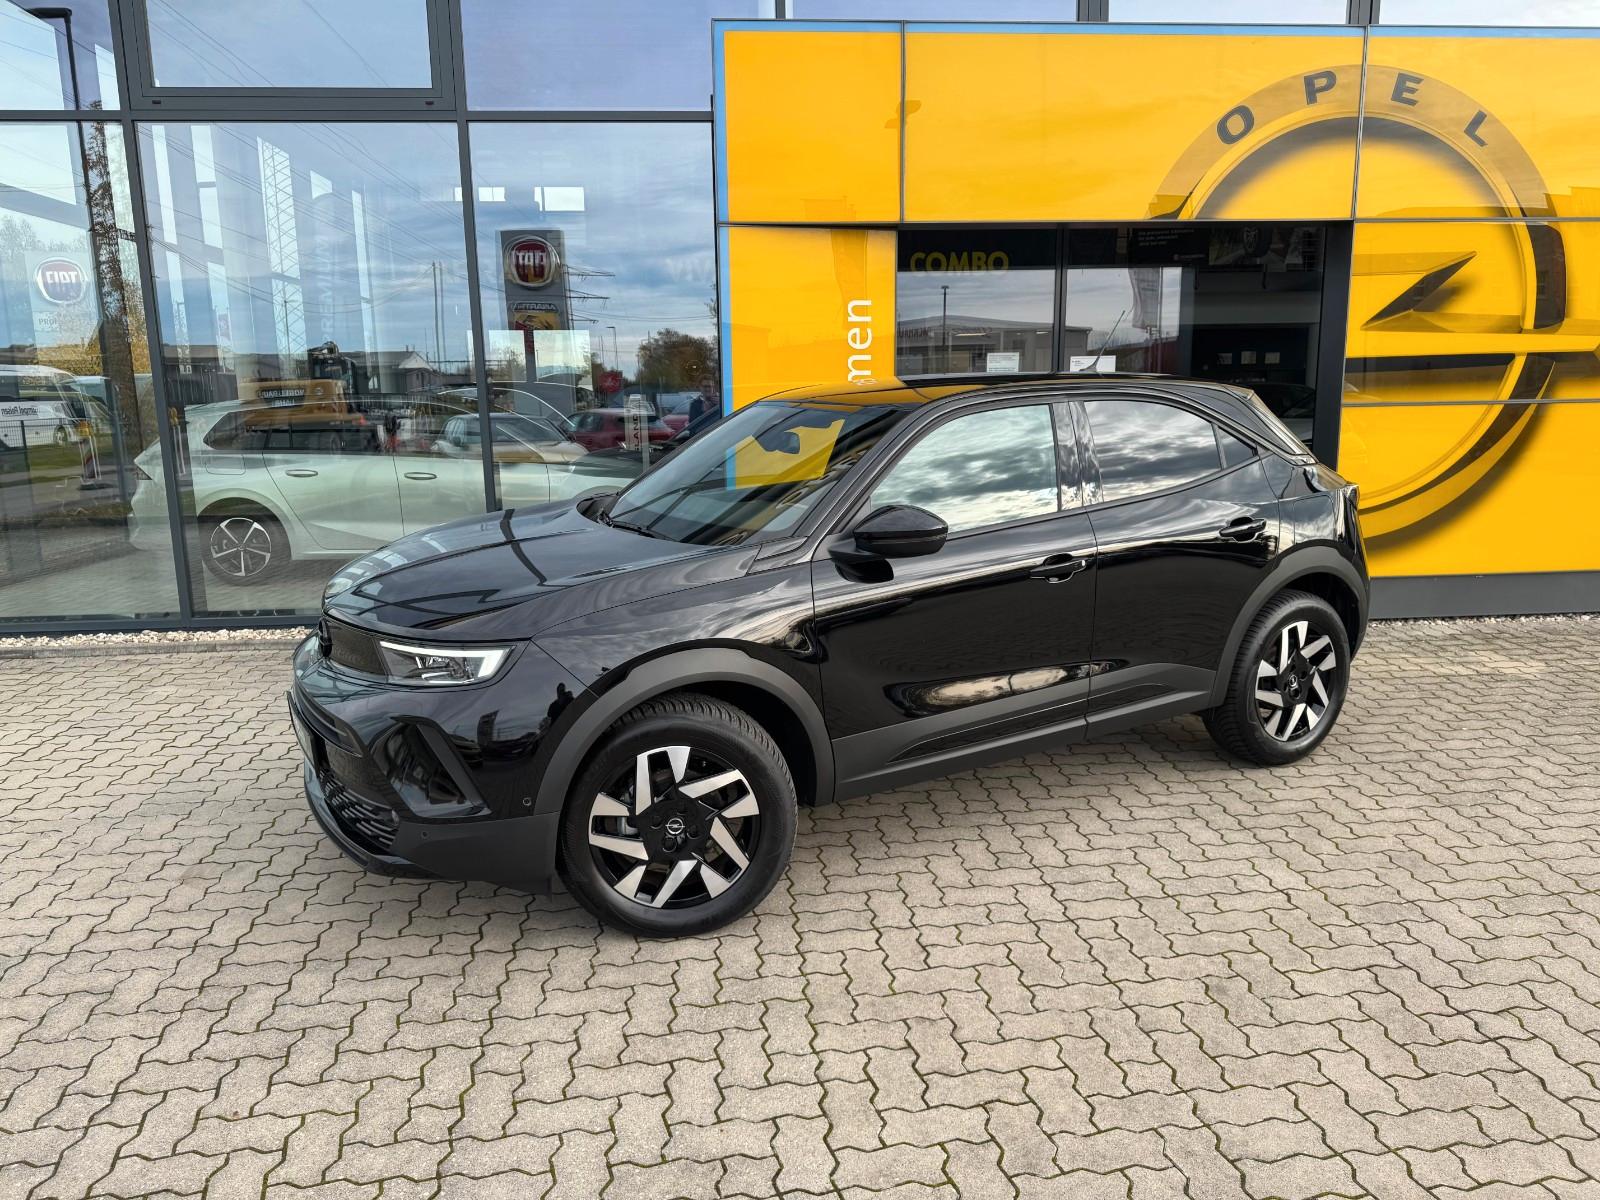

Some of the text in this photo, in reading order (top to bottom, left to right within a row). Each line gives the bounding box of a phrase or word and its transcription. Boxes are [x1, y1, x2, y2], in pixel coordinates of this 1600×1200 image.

[1216, 69, 1489, 148] OPEL
[909, 250, 1010, 277] COMBO
[45, 271, 78, 284] FIAT
